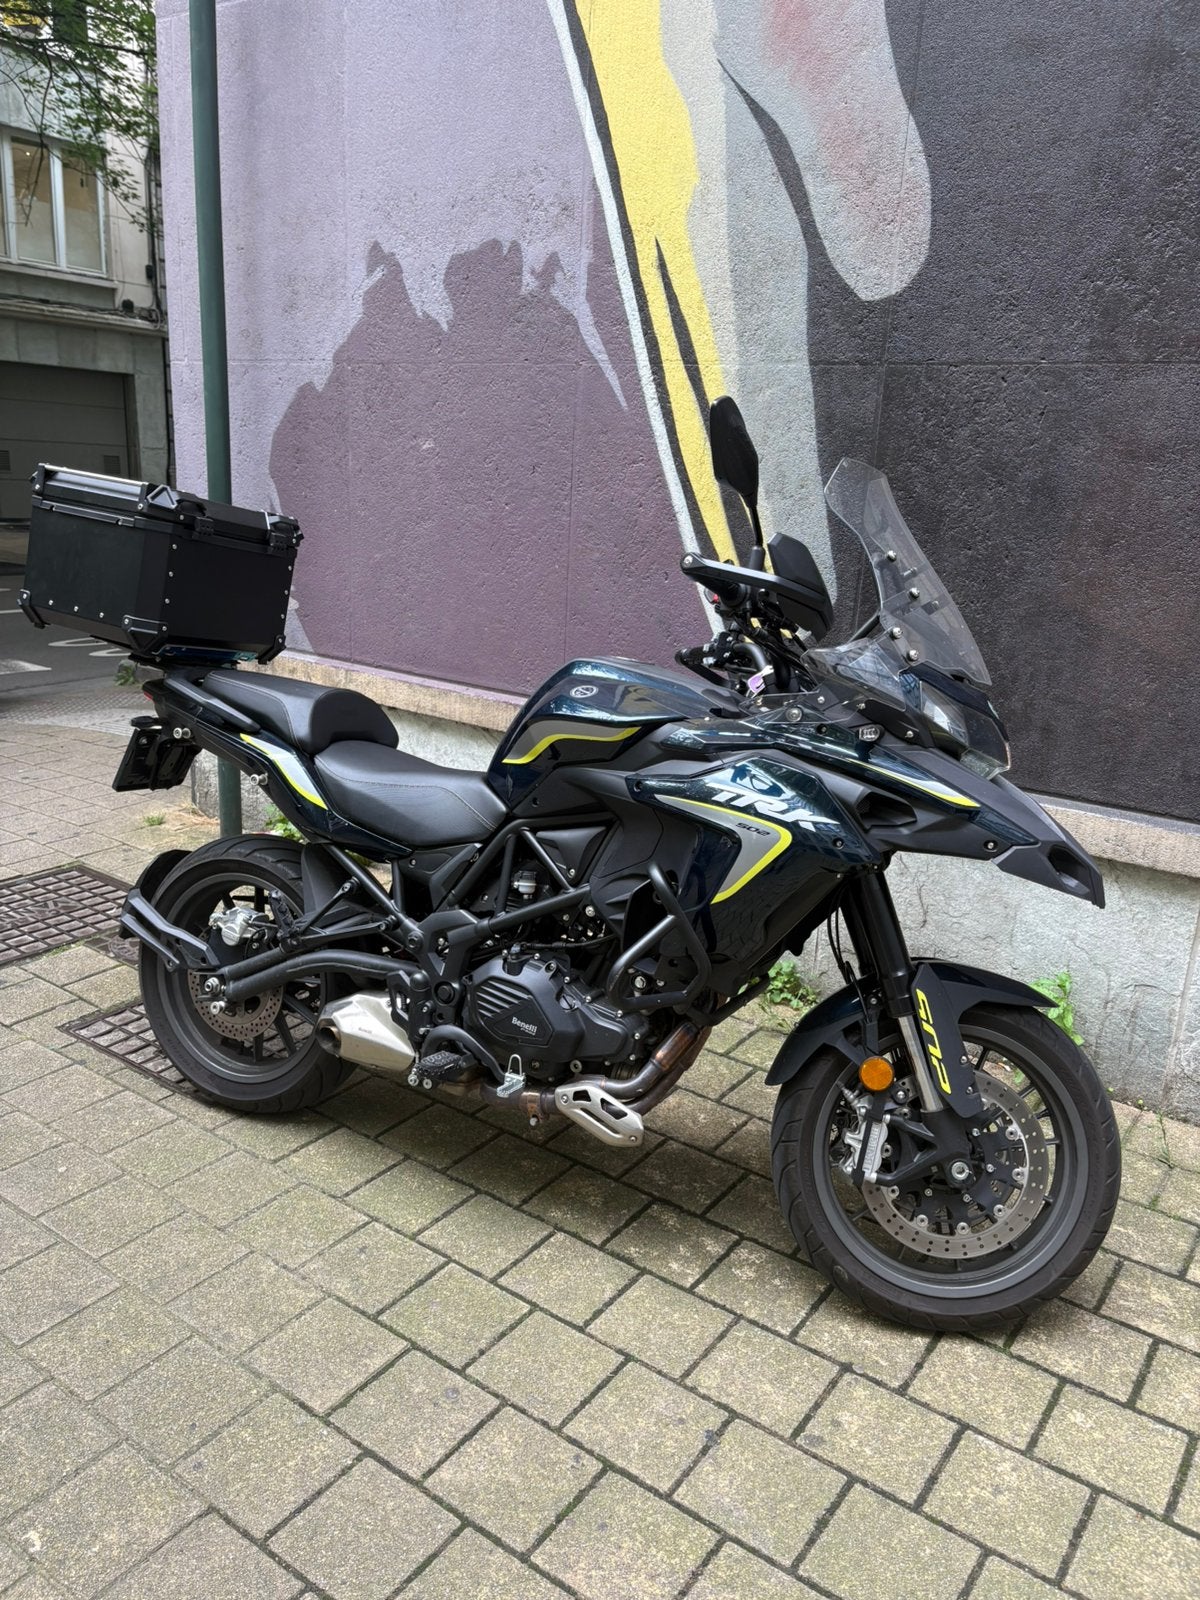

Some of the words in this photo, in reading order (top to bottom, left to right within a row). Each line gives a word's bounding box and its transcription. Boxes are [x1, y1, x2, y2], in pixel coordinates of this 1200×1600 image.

[705, 782, 840, 832] TRK
[735, 822, 771, 836] 502
[511, 1016, 537, 1033] Benelli
